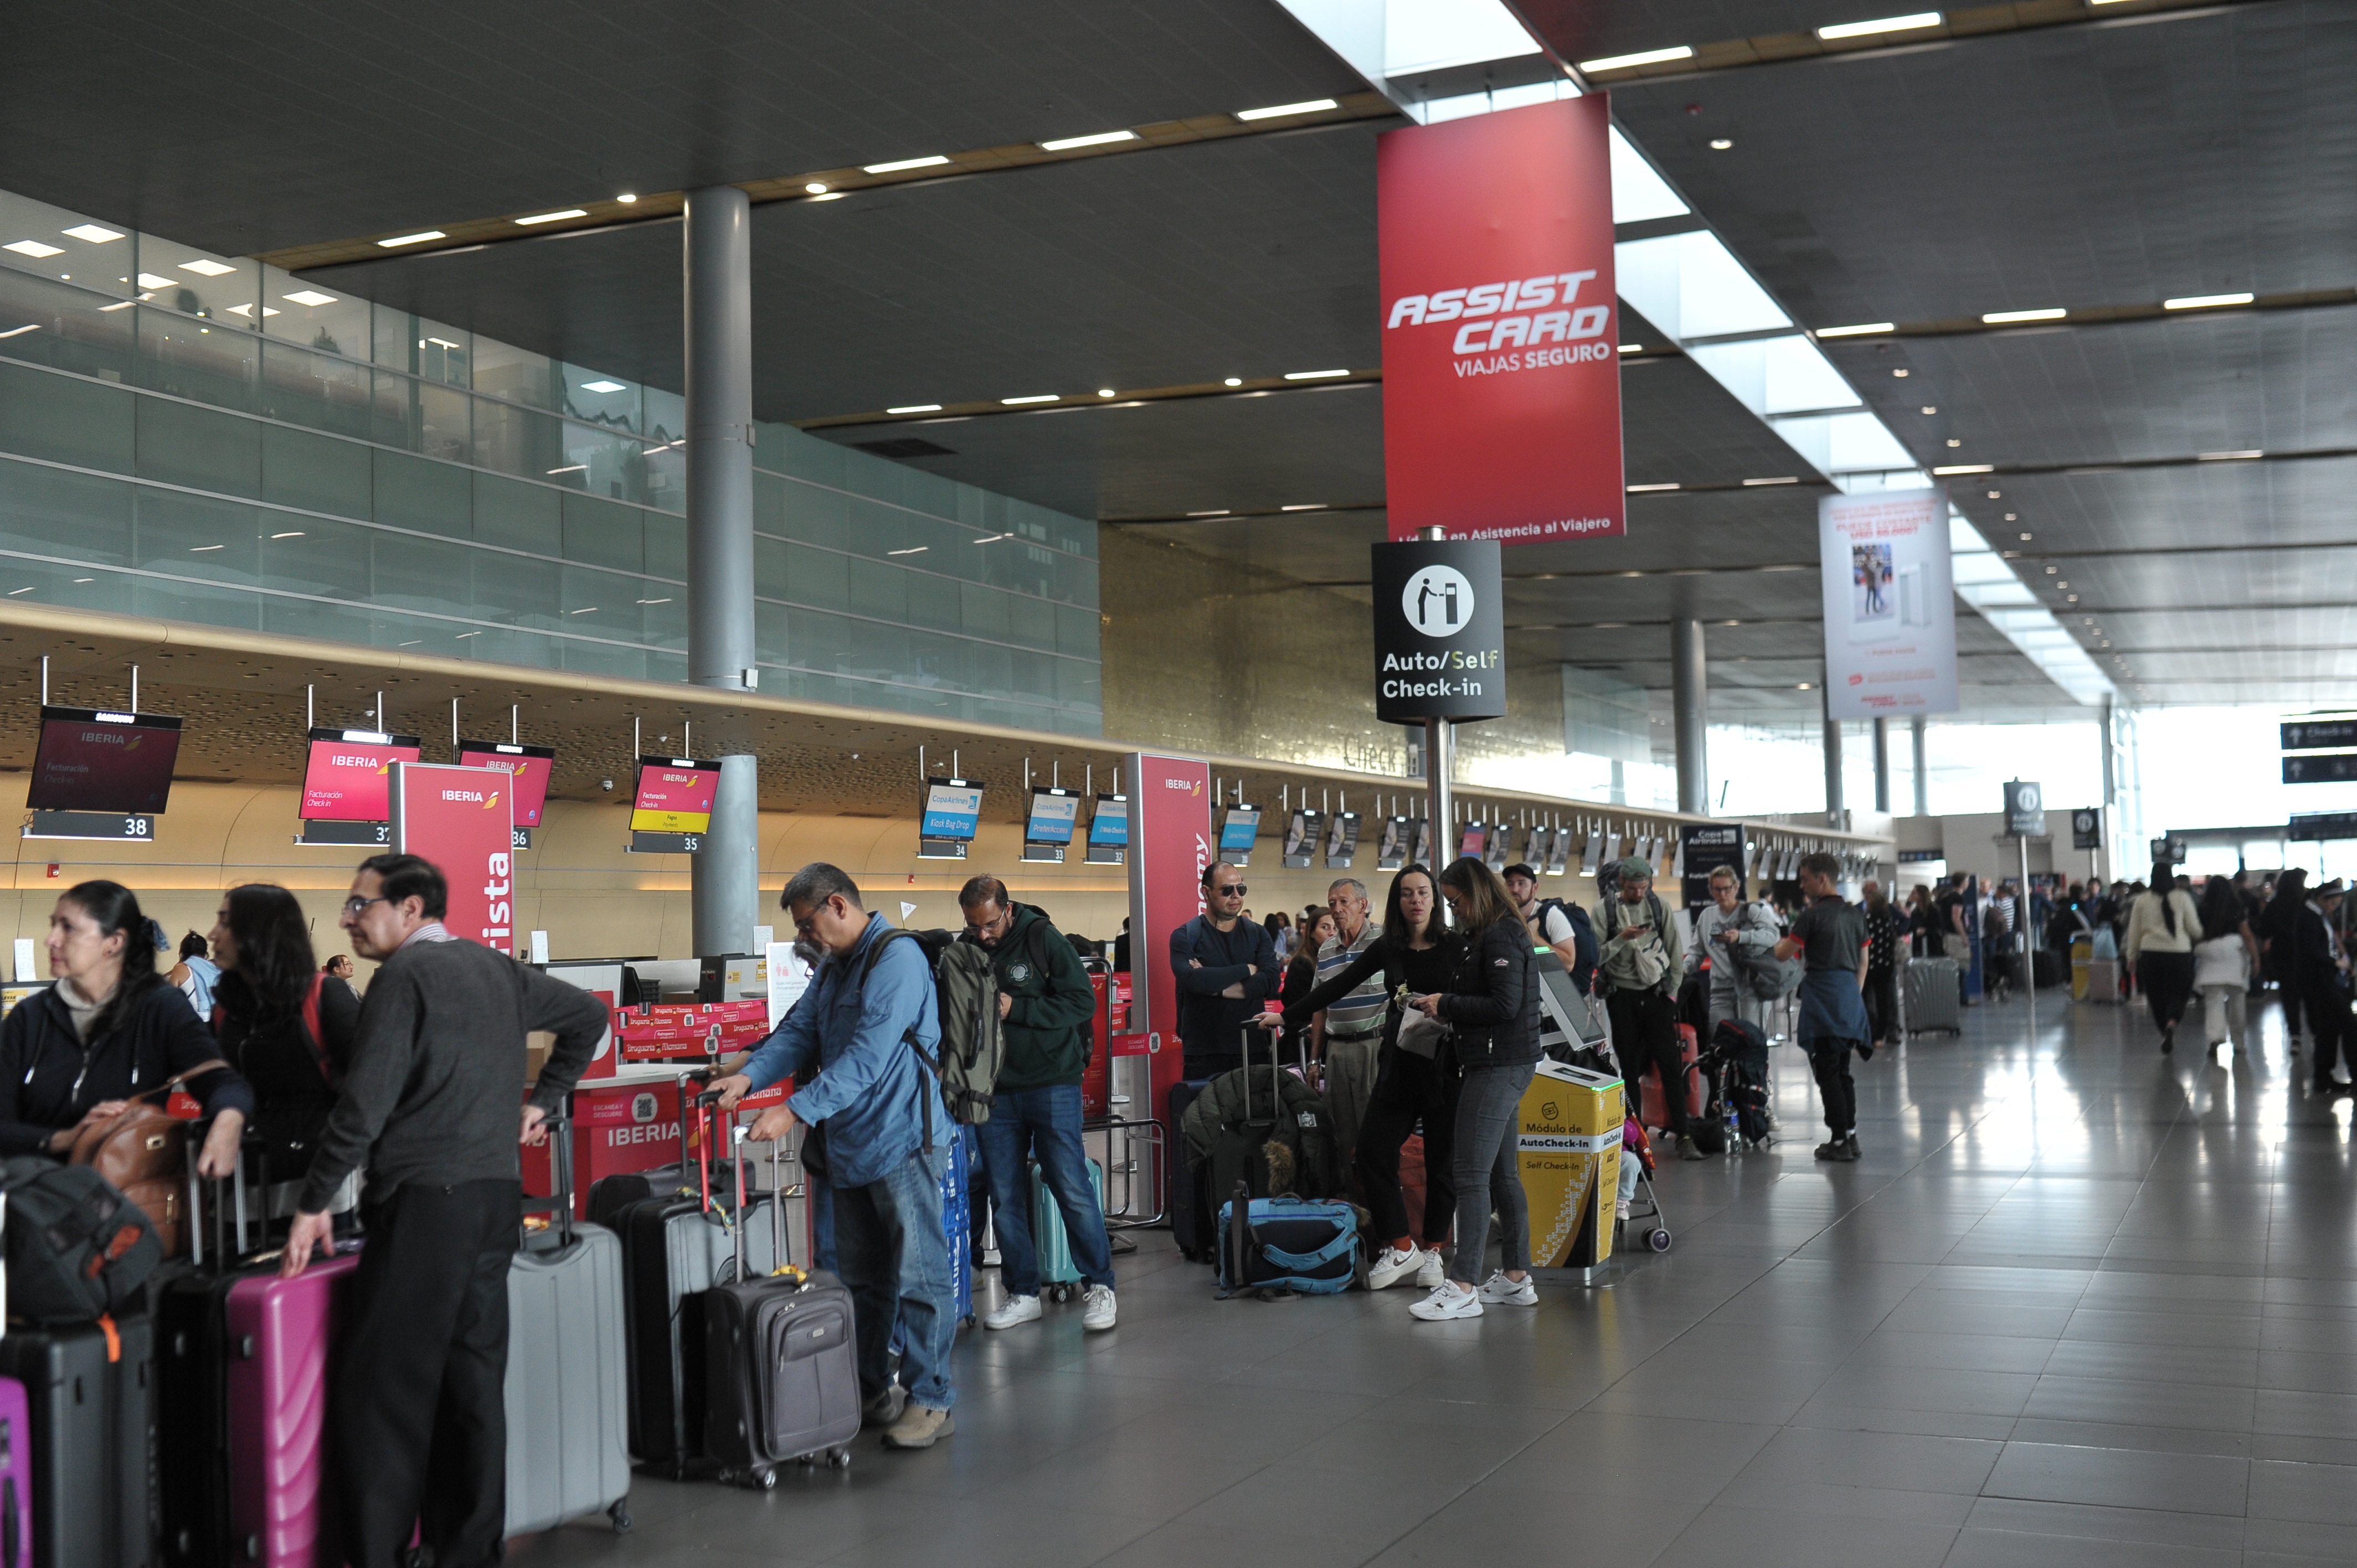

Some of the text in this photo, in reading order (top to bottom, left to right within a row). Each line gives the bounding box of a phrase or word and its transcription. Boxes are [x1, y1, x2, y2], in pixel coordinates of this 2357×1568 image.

[1387, 269, 1597, 329] ASSIST
[1452, 304, 1610, 355] CARD
[1453, 341, 1611, 378] VIAJAS SEGURO
[1451, 531, 1467, 540] en
[1471, 526, 1541, 540] Asistencia
[1545, 522, 1557, 534] al
[1560, 518, 1611, 534] Viajero
[1383, 678, 1482, 698] Check-in
[81, 733, 125, 744] IBERIA
[332, 755, 378, 768] IBERIA
[486, 760, 515, 770] IBERIA
[47, 762, 89, 773] Facturación
[44, 775, 74, 784] Check-in
[663, 773, 687, 782] IBERIA
[1165, 778, 1191, 791] IBERIA
[308, 790, 342, 798] Facturación
[442, 790, 483, 802] IBERIA
[125, 818, 147, 835] 38
[930, 818, 969, 832] Kiosk Bag Drop
[512, 831, 527, 845] 36
[1698, 830, 1722, 839] Copa
[685, 838, 697, 850] 35
[956, 845, 965, 856] 34
[1055, 849, 1063, 860] 33
[1115, 852, 1123, 862] 32
[627, 1044, 655, 1054] Droguería
[1526, 1123, 1582, 1133] Módulo de
[608, 1122, 681, 1147] IBERIA
[1520, 1138, 1589, 1148] AutoCheck-In
[1543, 1162, 1579, 1170] Check-In
